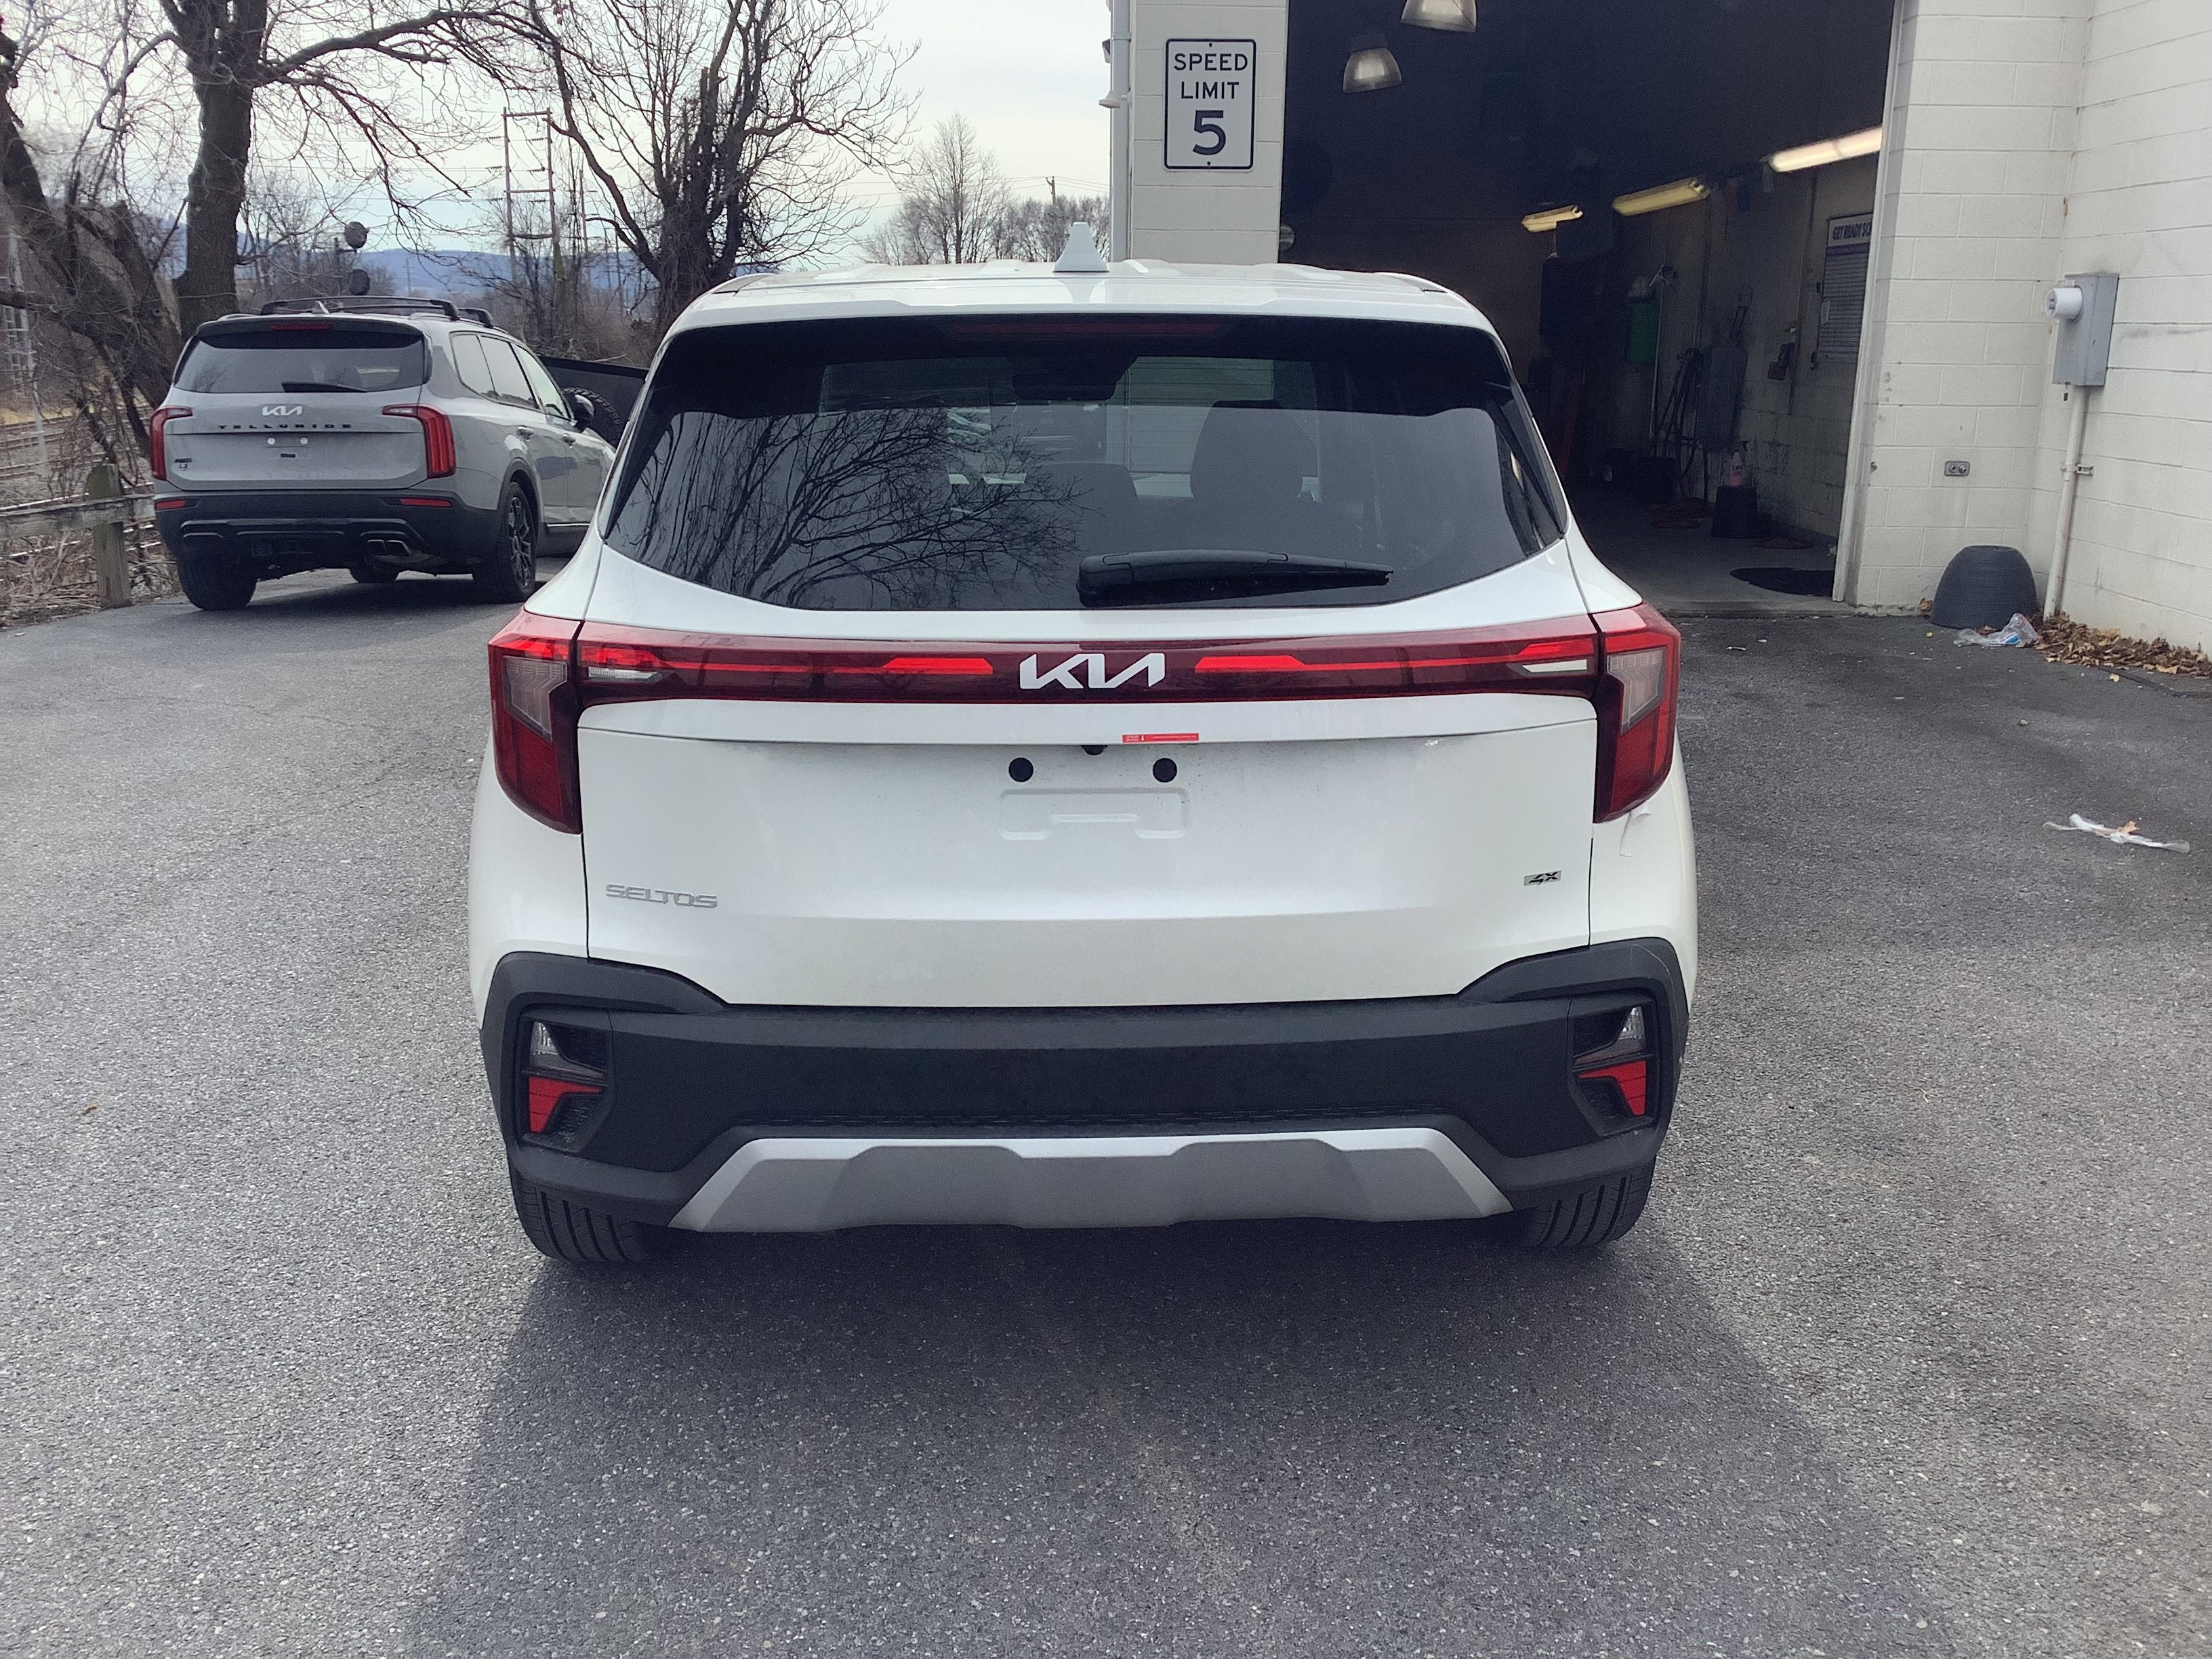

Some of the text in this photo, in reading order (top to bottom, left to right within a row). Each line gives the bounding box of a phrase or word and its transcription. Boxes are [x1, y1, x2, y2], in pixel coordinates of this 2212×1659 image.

[1174, 53, 1248, 71] SPEED
[1181, 81, 1240, 100] LIMIT
[1192, 110, 1227, 155] 5
[1832, 226, 1844, 240] GET
[1843, 222, 1863, 239] READY
[262, 405, 303, 416] KIA
[1019, 653, 1166, 689] KIA
[605, 882, 718, 909] SELTOS
